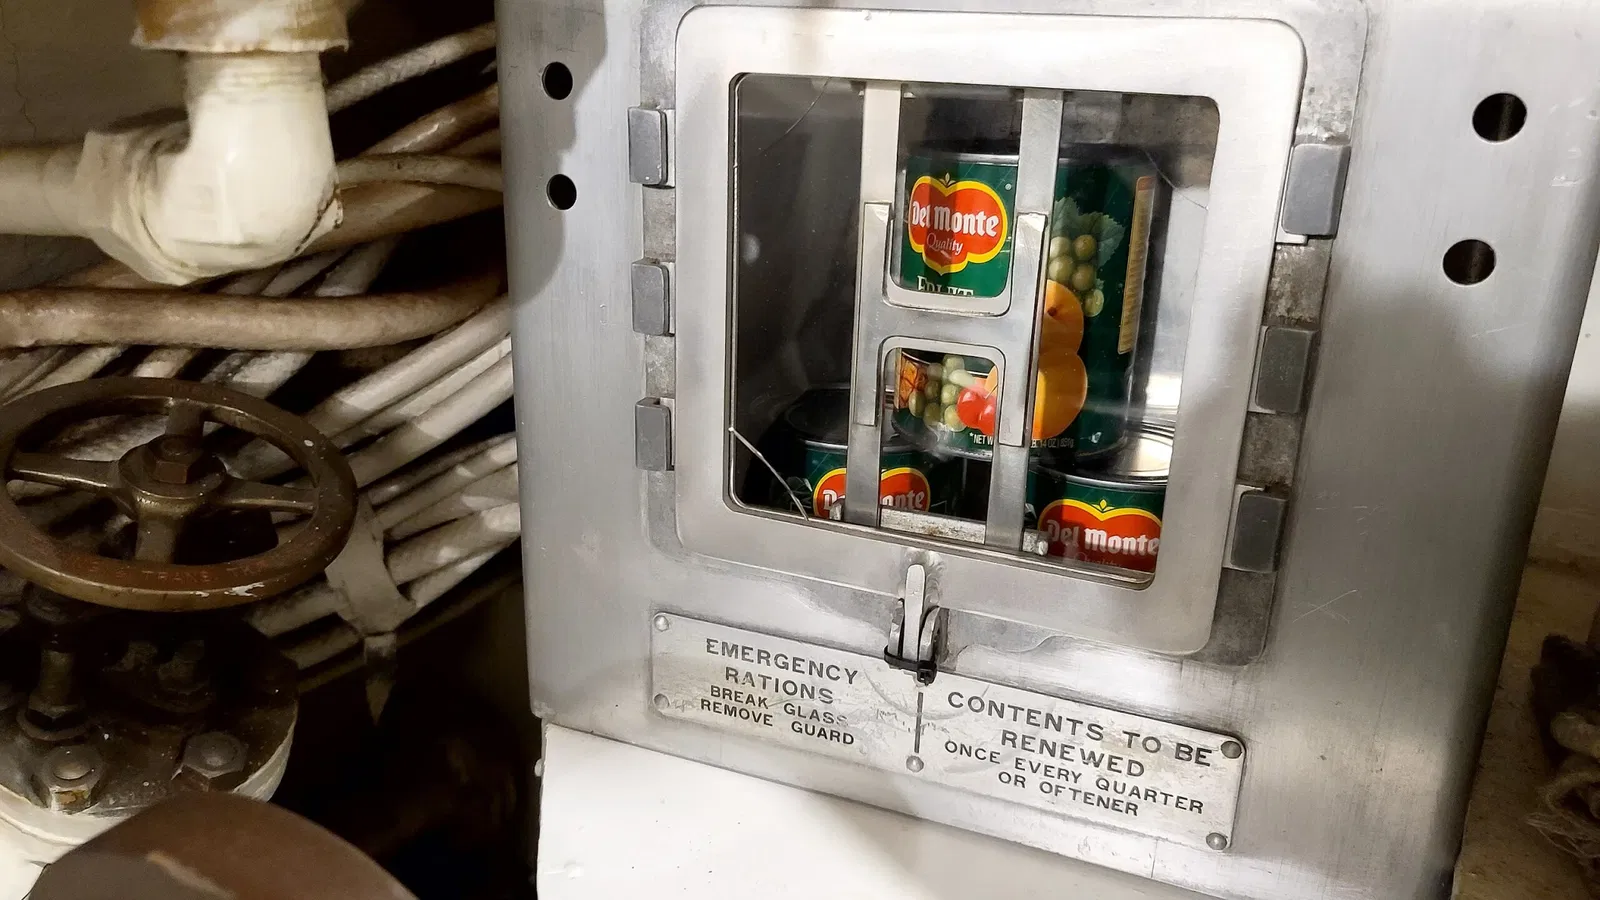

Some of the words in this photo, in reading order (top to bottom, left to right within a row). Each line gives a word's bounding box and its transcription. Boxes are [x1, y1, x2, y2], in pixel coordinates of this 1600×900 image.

[912, 203, 931, 227] Del
[934, 205, 999, 237] Monte
[926, 232, 964, 256] Quality
[1047, 519, 1080, 546] Del
[1084, 527, 1160, 555] Monte
[706, 638, 858, 685] EMERGENCY
[710, 685, 769, 710] BREAK
[783, 703, 849, 726] GLASS
[725, 666, 834, 705] RATIONS
[700, 698, 773, 727] REMOVE
[791, 720, 854, 745] GUARD
[947, 691, 1104, 741] CONTENTS
[1122, 730, 1162, 754] TO
[1174, 742, 1213, 767] BE
[1001, 729, 1145, 778] RENEWED
[944, 740, 1001, 765] ONCE
[1014, 757, 1082, 784] EVERY
[1095, 778, 1204, 815] QUARTER
[998, 771, 1026, 789] OR
[1039, 781, 1139, 817] OFTENER
